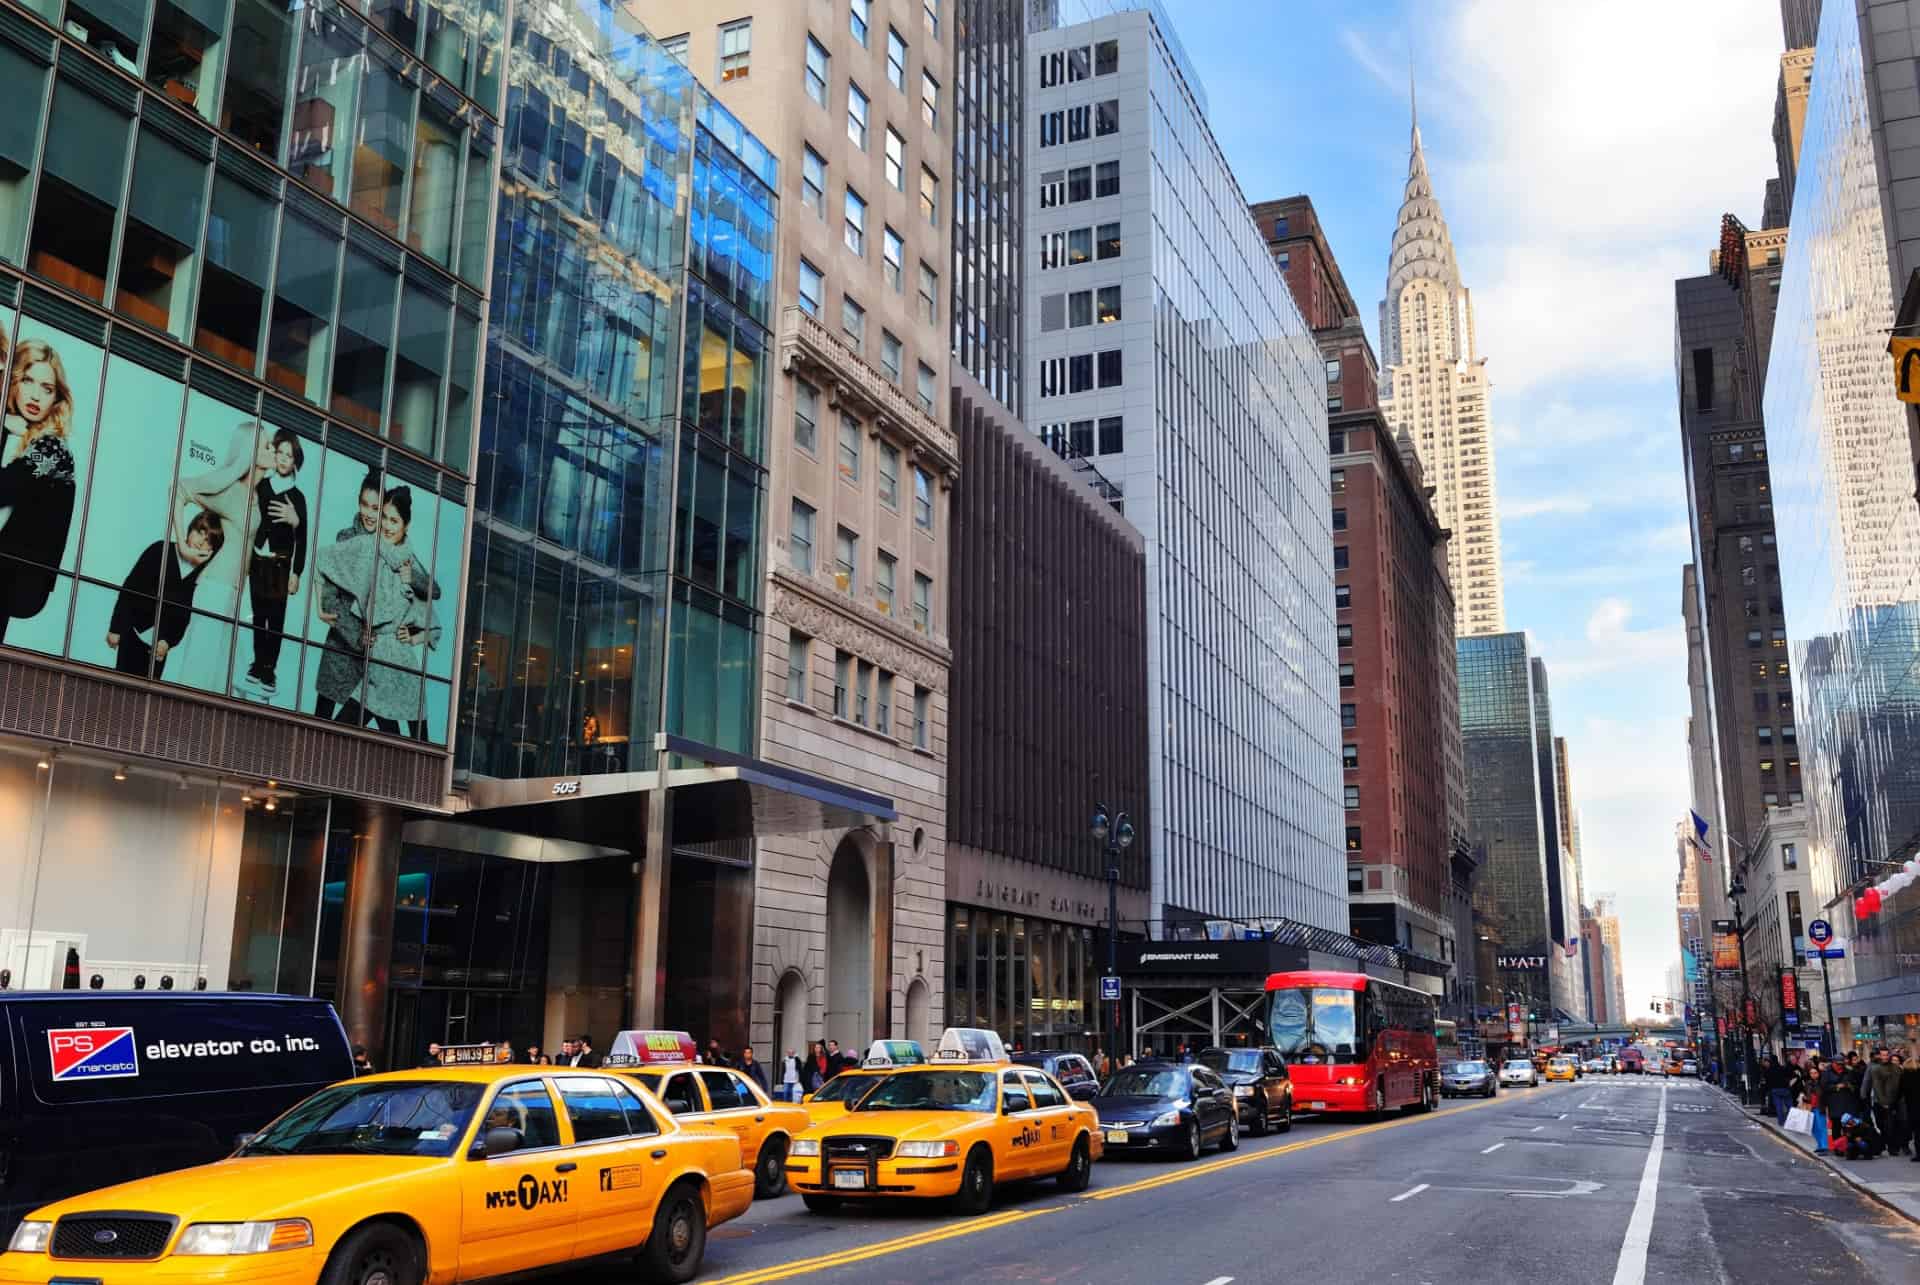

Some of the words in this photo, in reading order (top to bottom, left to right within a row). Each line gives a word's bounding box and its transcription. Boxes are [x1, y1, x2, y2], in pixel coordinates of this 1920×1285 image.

[552, 782, 579, 795] 505
[1193, 953, 1220, 961] BANK
[1498, 956, 1546, 969] HYATT
[54, 1036, 94, 1054] PS
[146, 1039, 244, 1060] elevator
[250, 1039, 281, 1053] co.
[285, 1034, 320, 1052] inc.
[456, 1048, 482, 1061] 9M39
[77, 1063, 134, 1073] marcato
